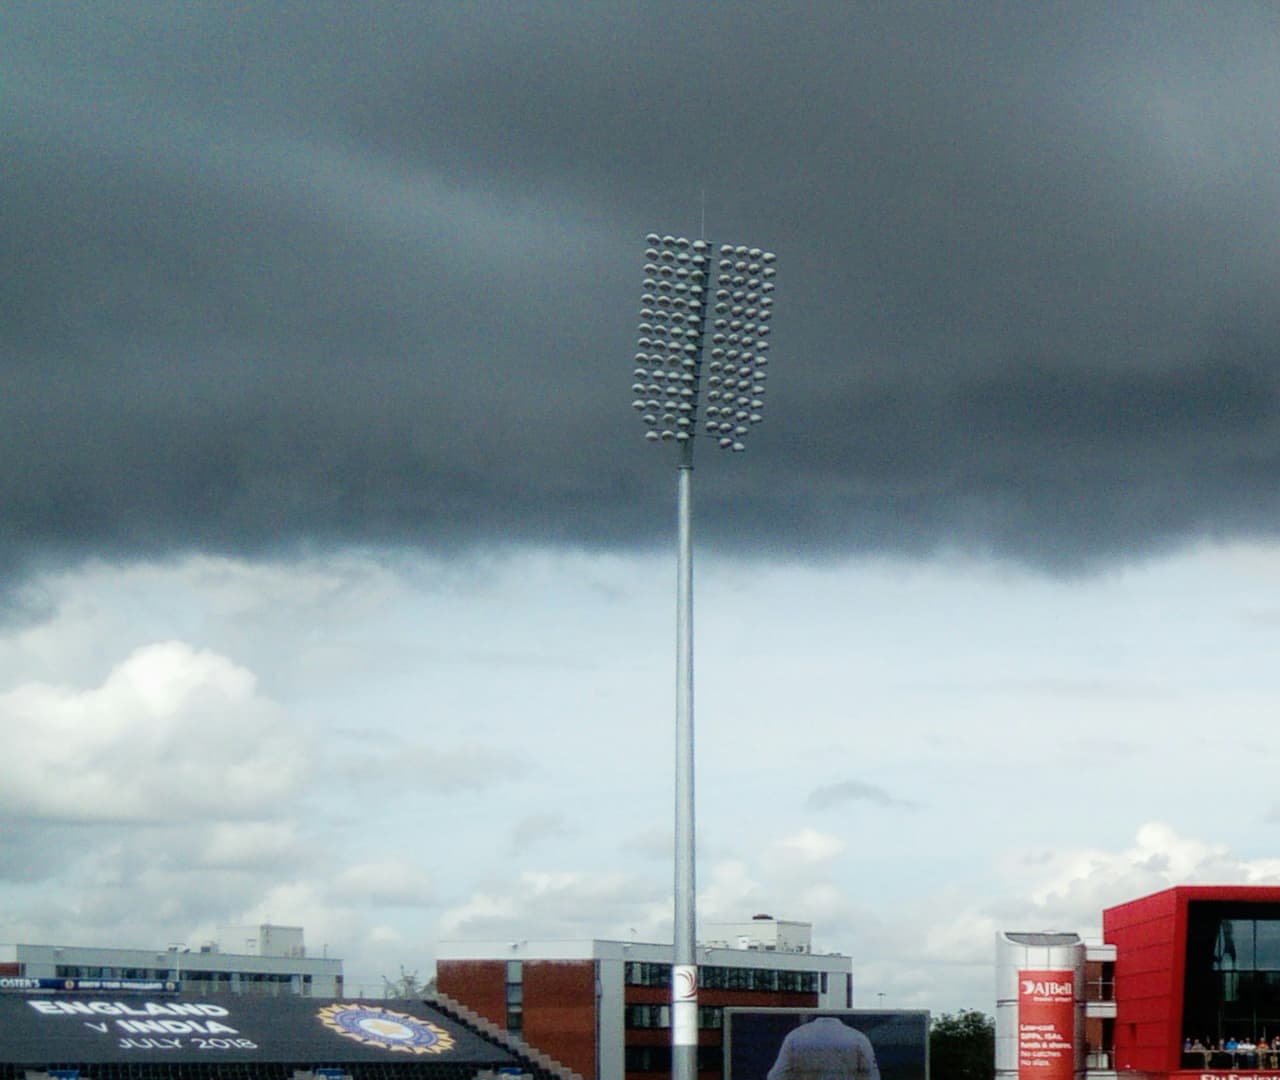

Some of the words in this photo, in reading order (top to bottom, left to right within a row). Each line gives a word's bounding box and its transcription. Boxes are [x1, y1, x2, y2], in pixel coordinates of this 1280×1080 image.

[0, 979, 40, 988] OSTER'S
[28, 1000, 229, 1017] ENGLAND
[115, 1020, 239, 1034] INDIA
[120, 1038, 182, 1049] JULY
[191, 1038, 258, 1049] 2018
